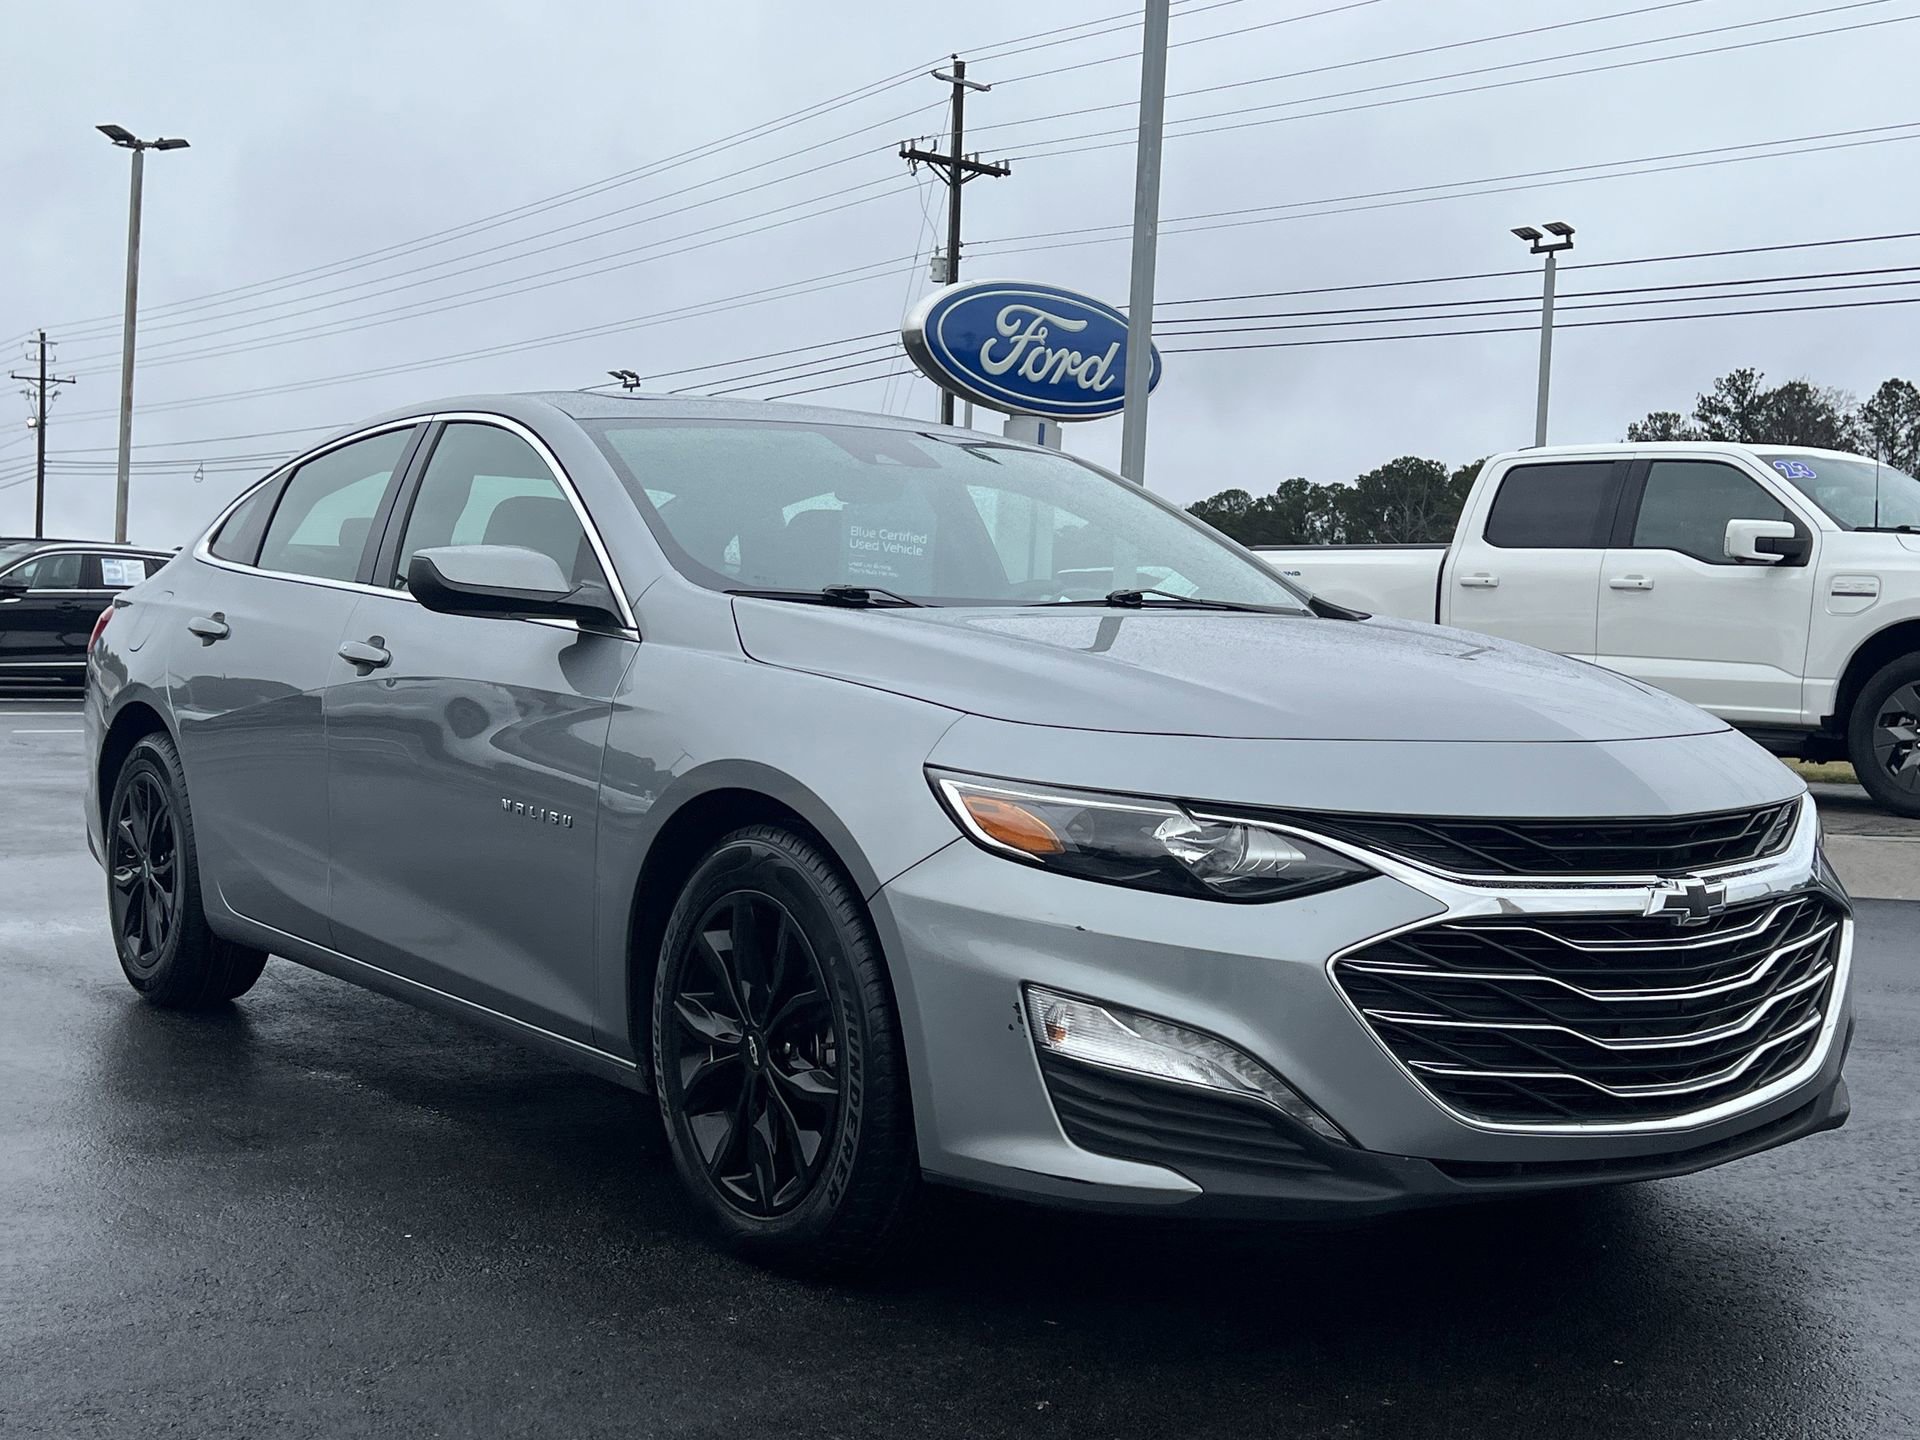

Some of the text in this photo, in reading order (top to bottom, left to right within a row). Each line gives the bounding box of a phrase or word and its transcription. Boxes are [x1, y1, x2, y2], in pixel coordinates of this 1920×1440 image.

[980, 304, 1121, 392] Ford
[1773, 460, 1817, 479] 23
[849, 538, 924, 556] Used Vehicle
[850, 525, 928, 545] Blue Certified
[501, 798, 573, 829] MALIBU
[828, 979, 864, 1208] THUNDERER
